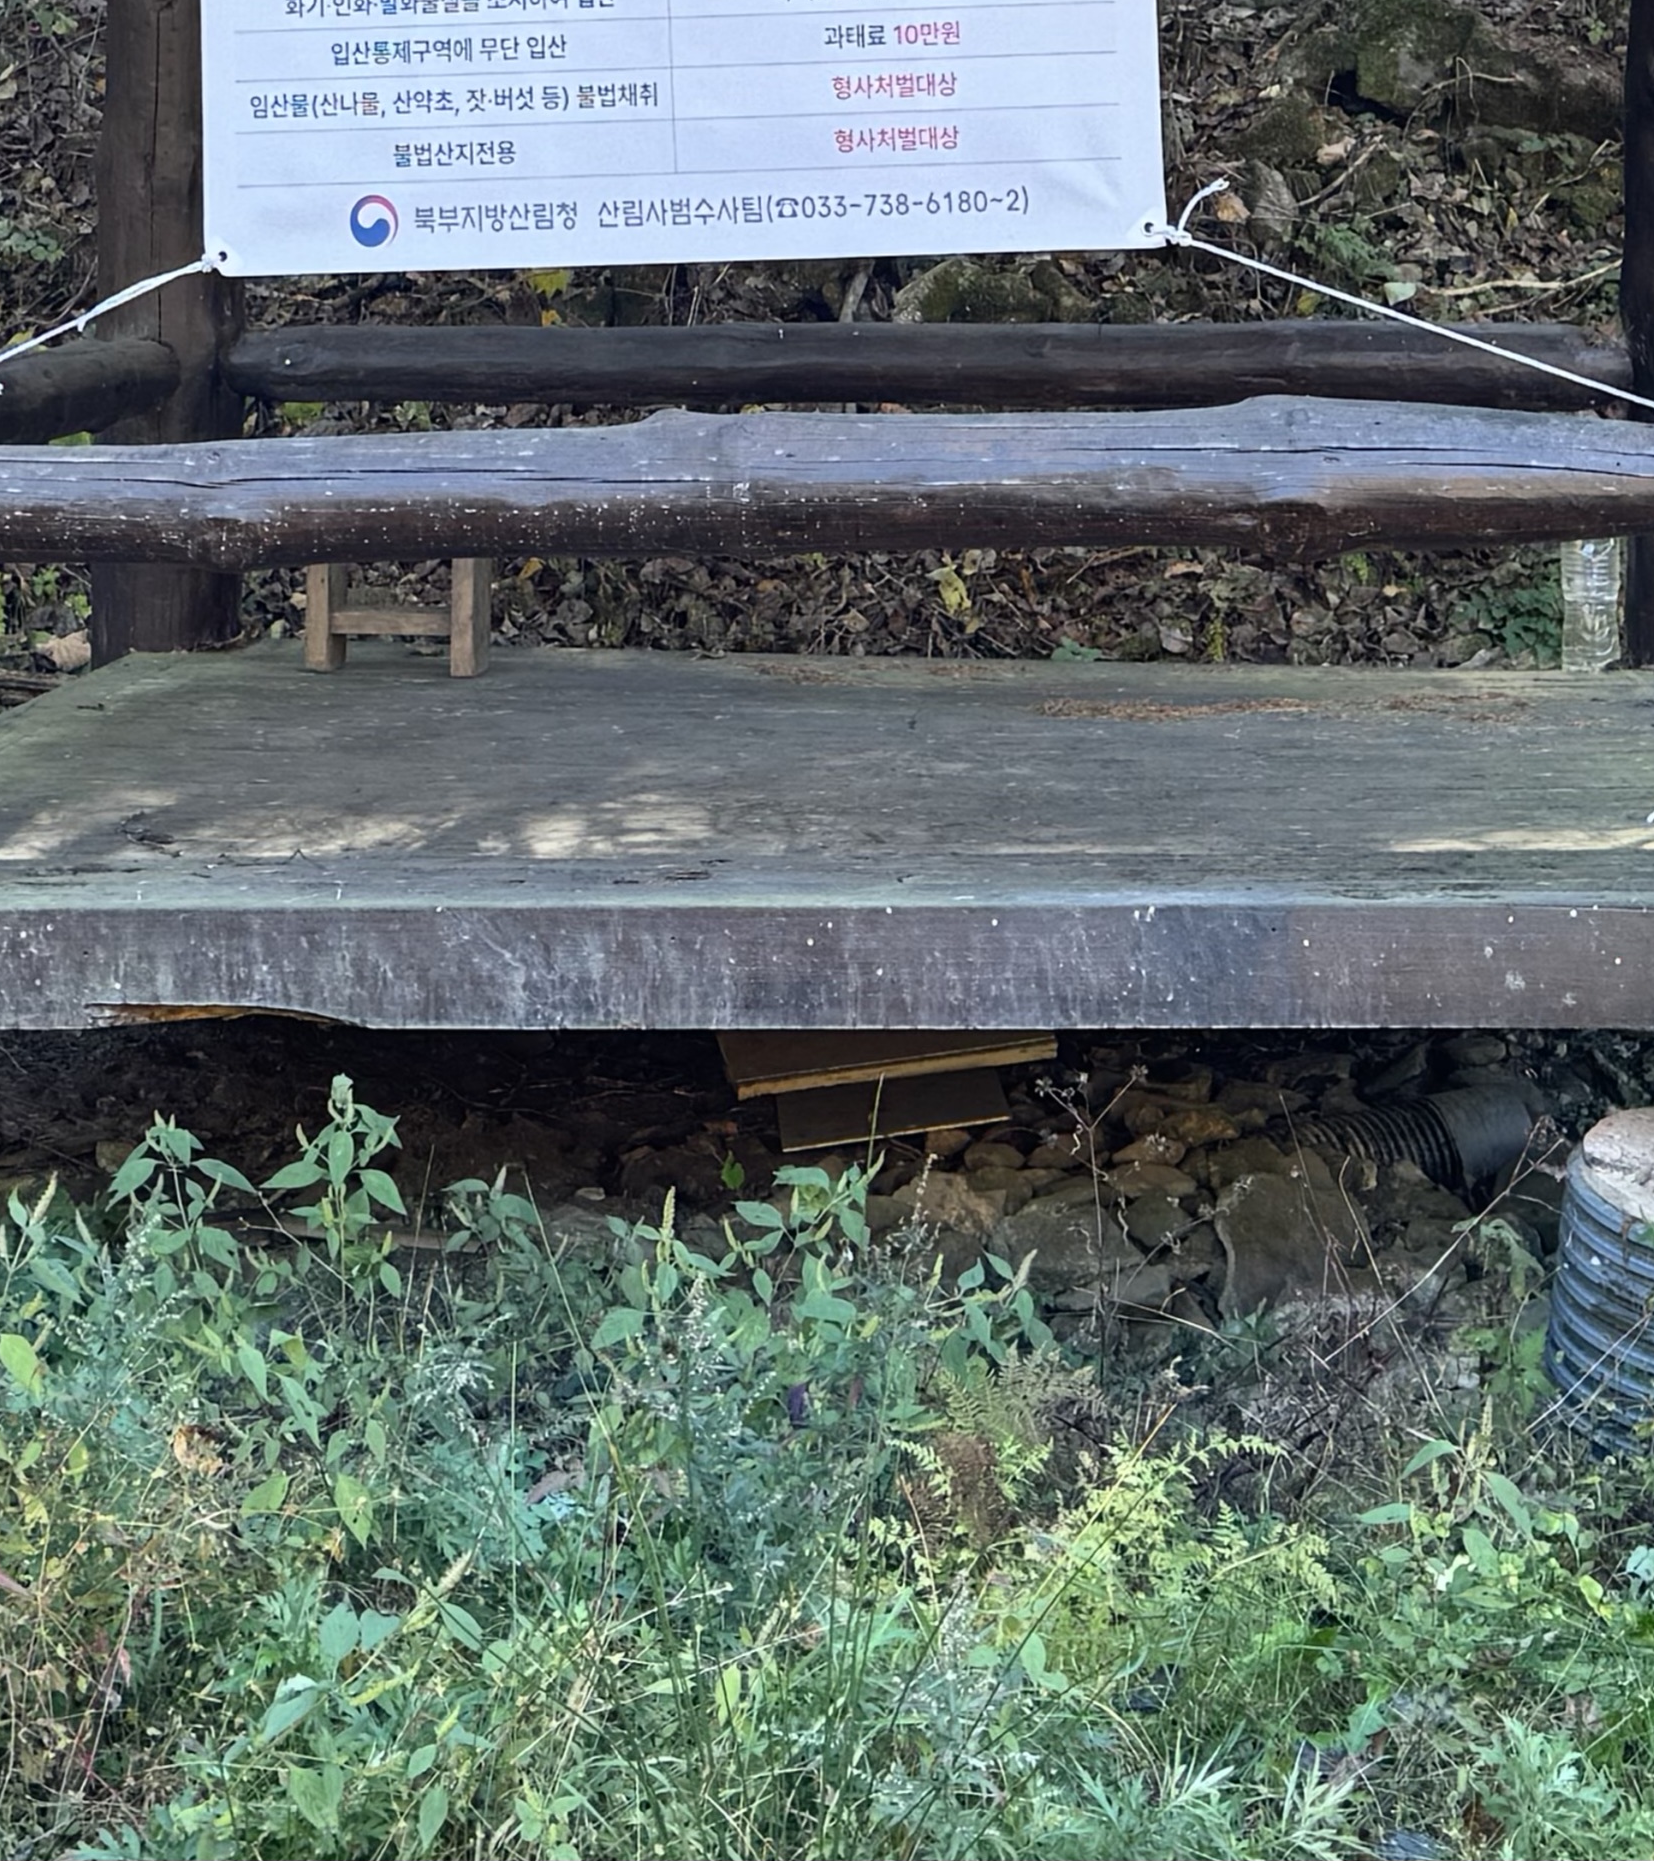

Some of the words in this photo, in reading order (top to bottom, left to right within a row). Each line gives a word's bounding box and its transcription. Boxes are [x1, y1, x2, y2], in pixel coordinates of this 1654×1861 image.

[824, 24, 886, 49] 과태료
[893, 21, 961, 46] 10만원
[331, 37, 473, 66] 입산통제구역에
[479, 35, 519, 61] 무단
[527, 34, 567, 60] 입산
[832, 72, 957, 100] 형사처벌대상
[249, 90, 386, 120] 임산물(산나물,
[393, 88, 459, 116] 산약초,
[541, 85, 570, 111] 등)
[576, 82, 659, 109] 불법채취
[834, 126, 959, 153] 형사처벌대상
[393, 141, 516, 168] 불법산지전용
[414, 202, 578, 233] 북부지방산림청
